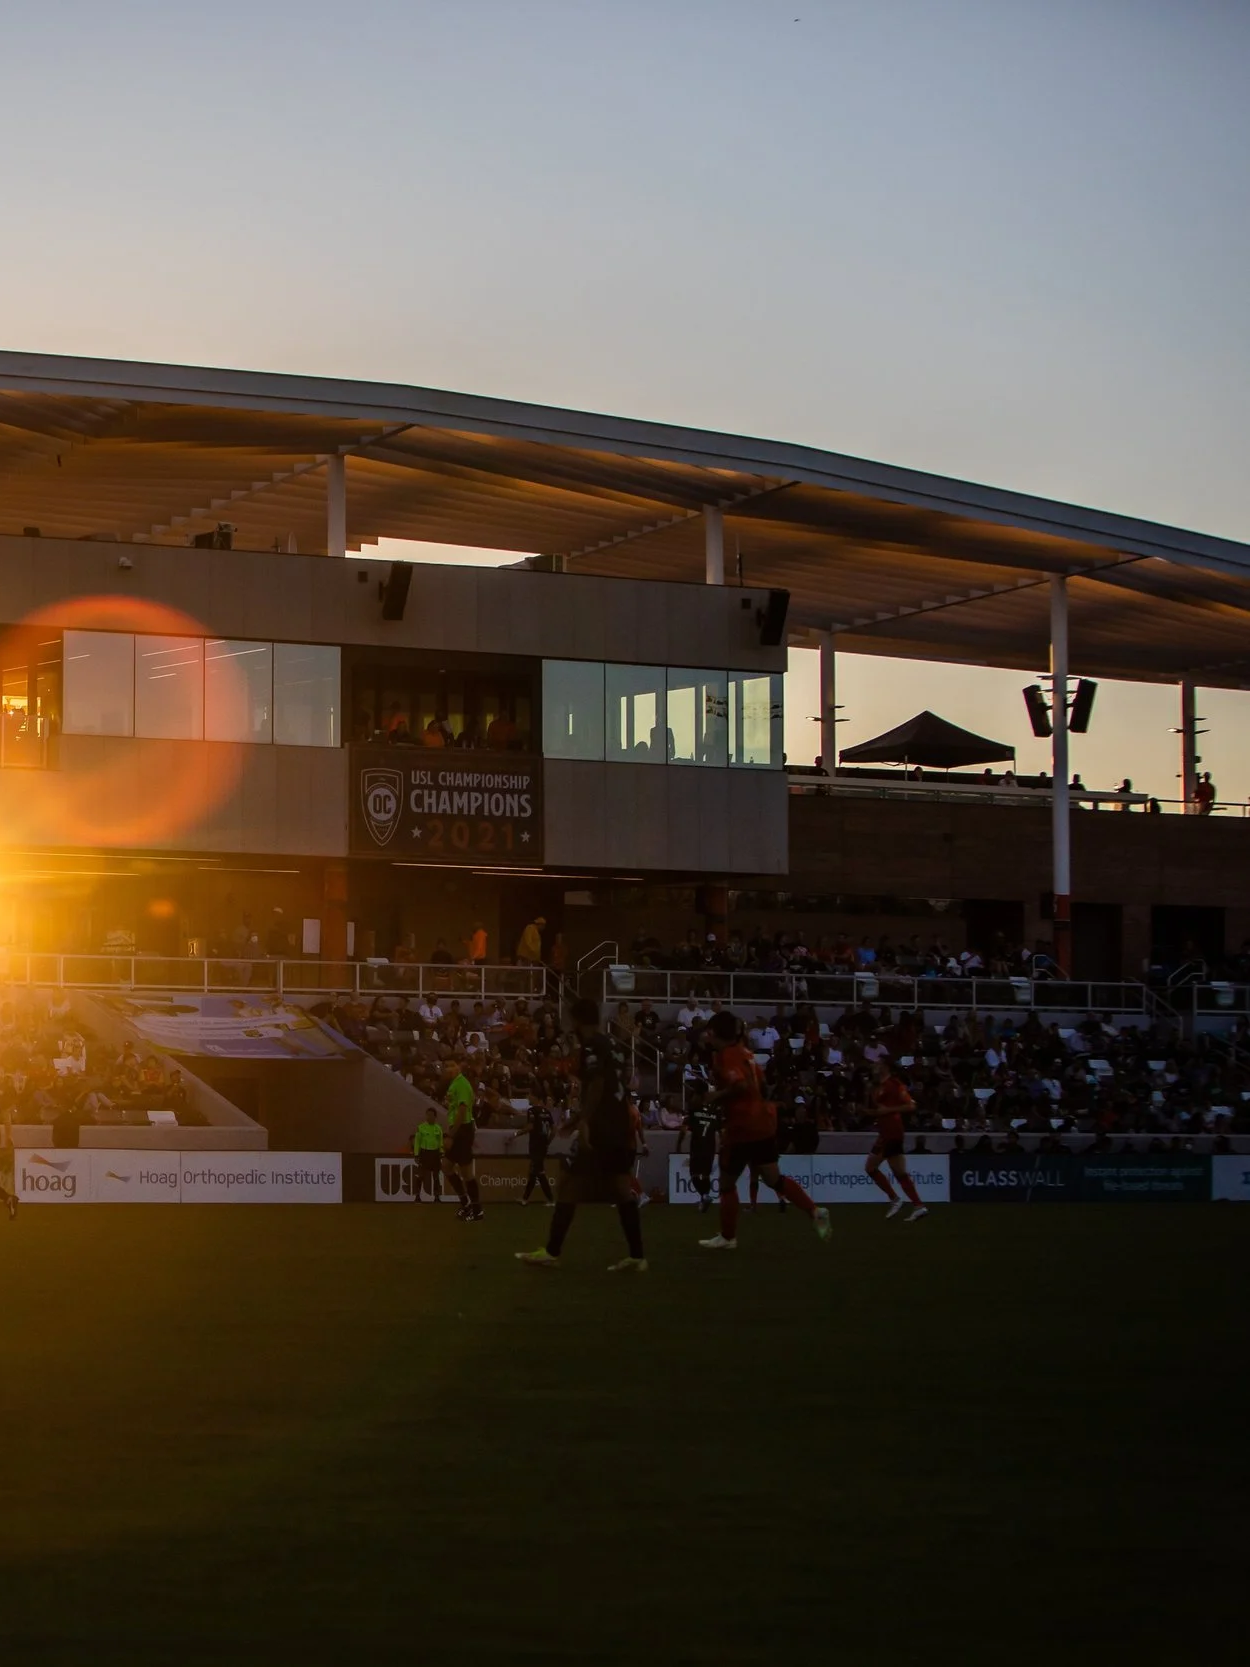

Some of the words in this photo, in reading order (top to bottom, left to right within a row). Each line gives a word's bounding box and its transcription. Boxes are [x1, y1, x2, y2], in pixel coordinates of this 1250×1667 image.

[411, 770, 433, 785] USL
[438, 772, 530, 789] CHAMPIONSHIP
[372, 794, 391, 814] OC
[410, 790, 532, 817] CHAMPIONS
[426, 819, 515, 850] 2021
[699, 1120, 710, 1136] 7
[22, 1168, 76, 1198] hoag
[139, 1170, 178, 1188] Hoag
[183, 1169, 267, 1188] Orthopedic
[271, 1170, 336, 1185] Institute
[962, 1169, 1065, 1187] GLASSWALL
